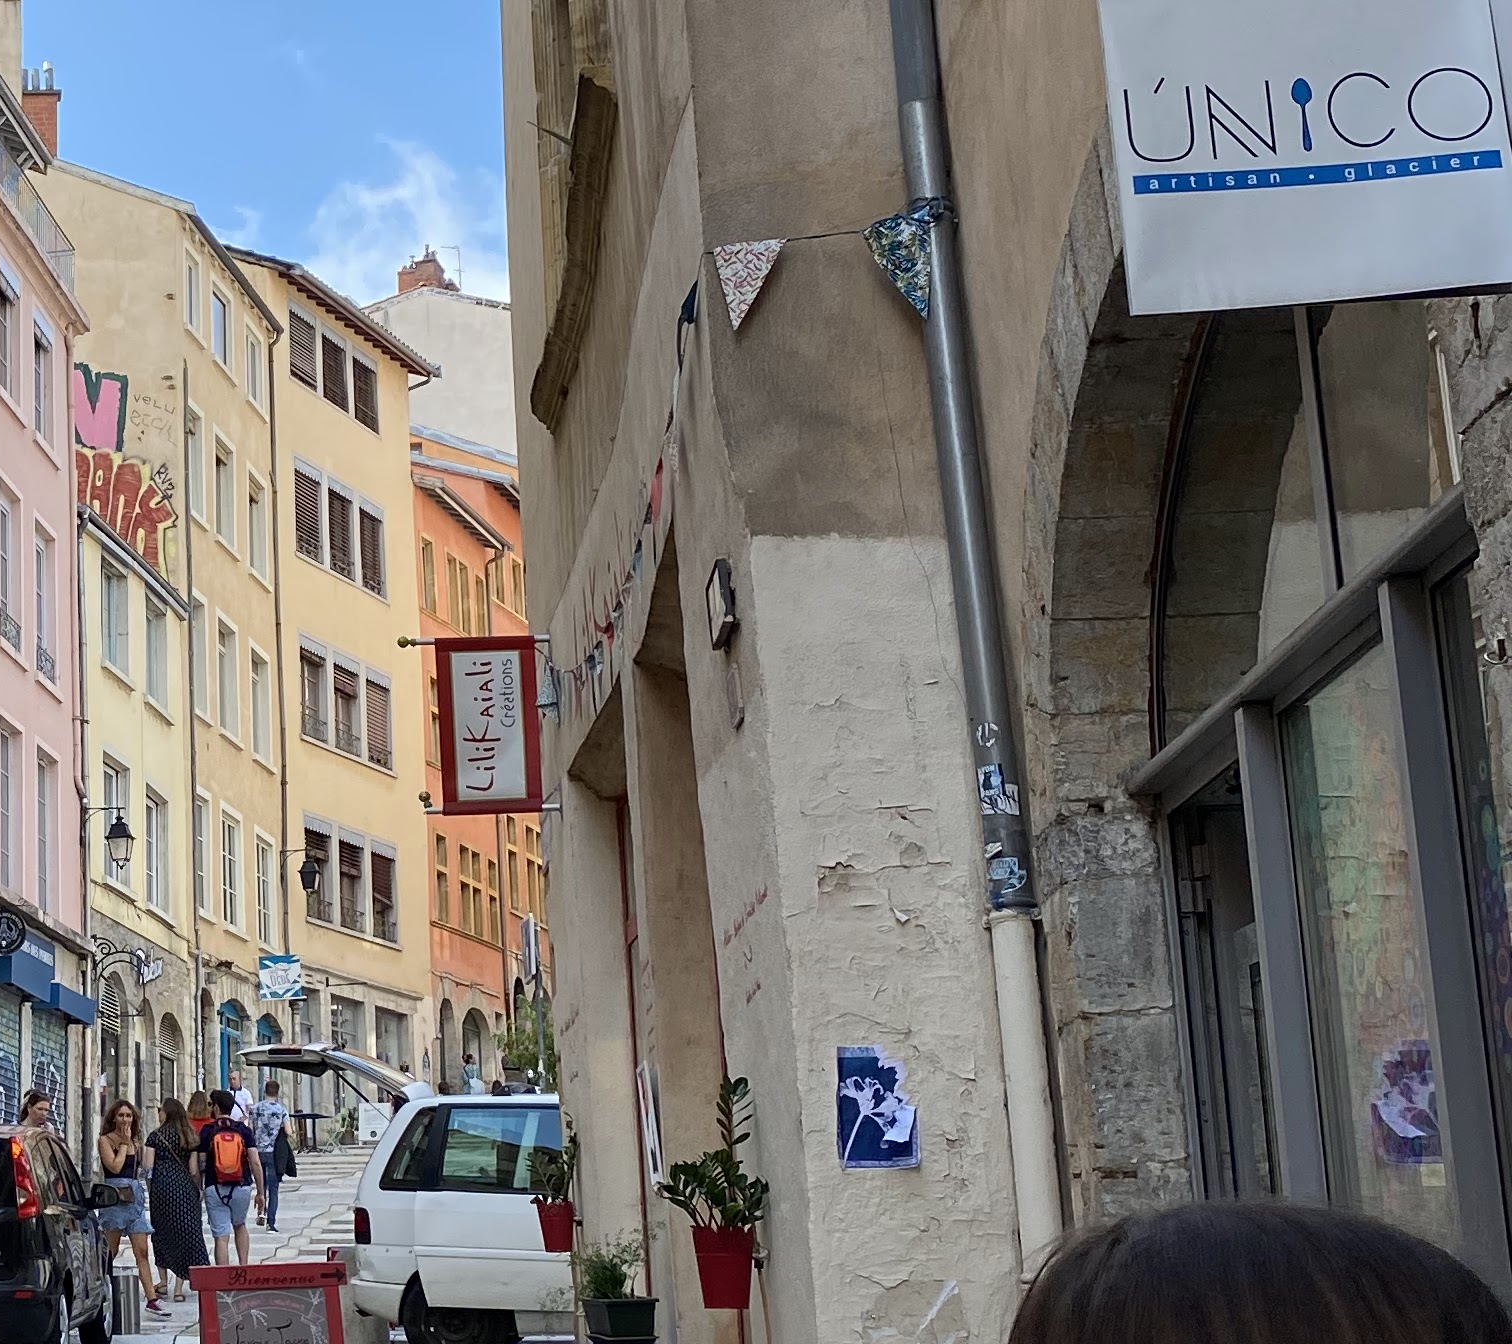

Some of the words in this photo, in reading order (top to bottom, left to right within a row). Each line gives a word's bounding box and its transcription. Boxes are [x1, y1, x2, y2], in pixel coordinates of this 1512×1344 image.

[1148, 170, 1281, 191] artisan
[1344, 156, 1481, 183] glacier
[498, 658, 516, 728] Créations
[228, 1268, 316, 1287] Bienvenue
